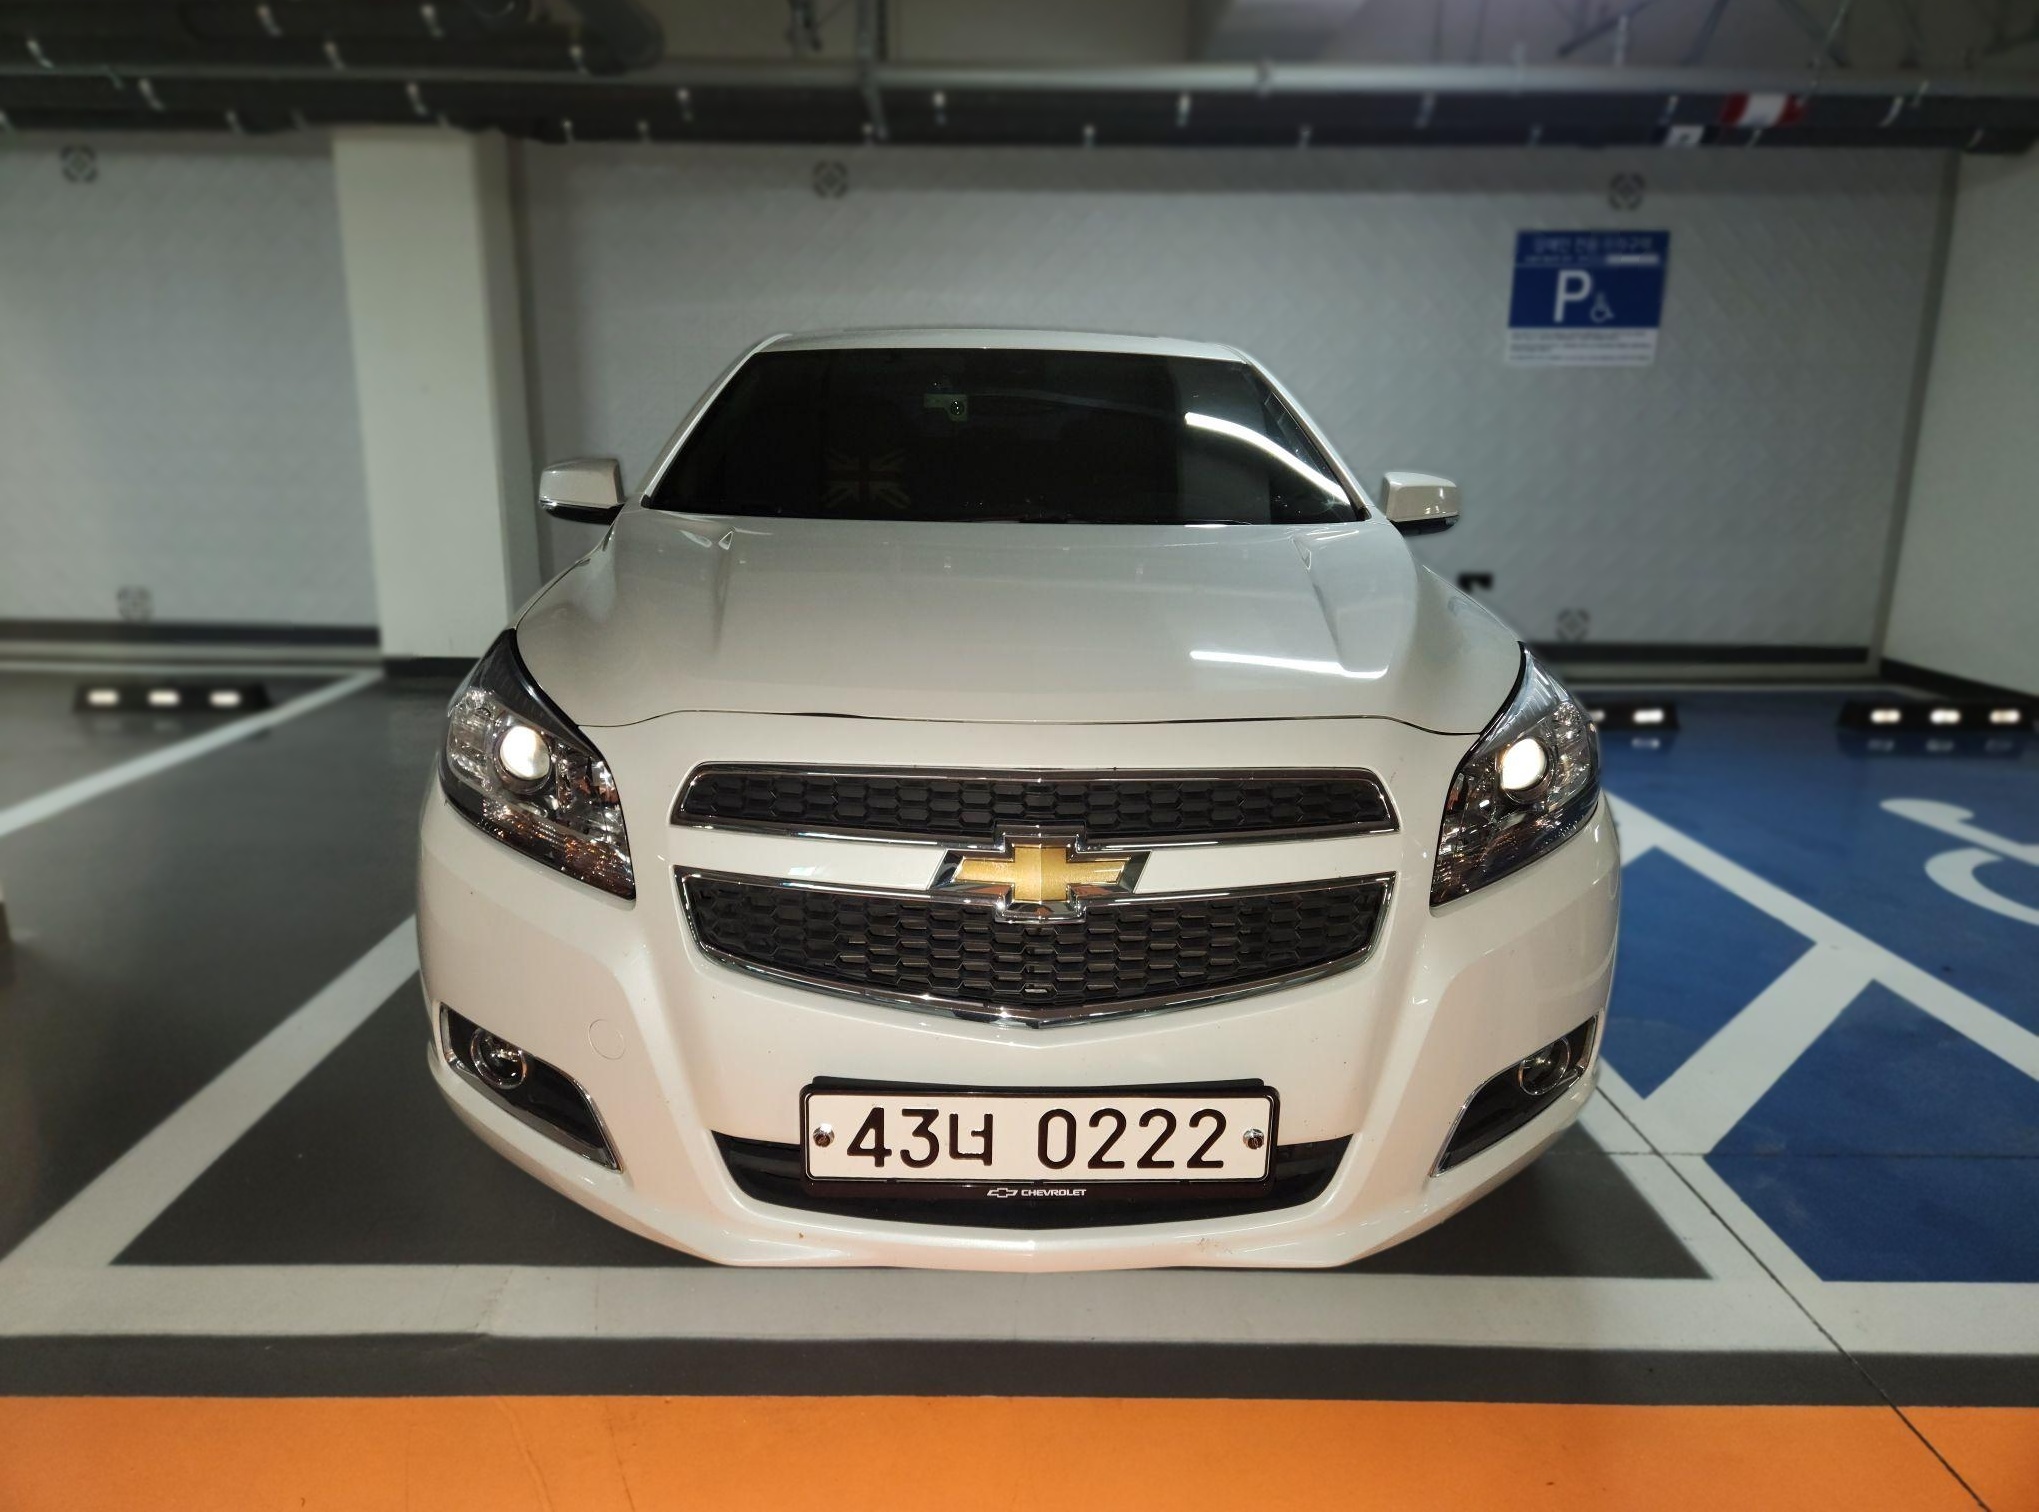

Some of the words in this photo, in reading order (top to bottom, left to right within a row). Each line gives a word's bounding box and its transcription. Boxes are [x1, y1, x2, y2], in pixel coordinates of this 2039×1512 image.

[1553, 269, 1592, 323] P
[846, 1107, 993, 1168] 43너
[1037, 1108, 1228, 1170] 0222
[1021, 1188, 1087, 1197] CHEVROLET
